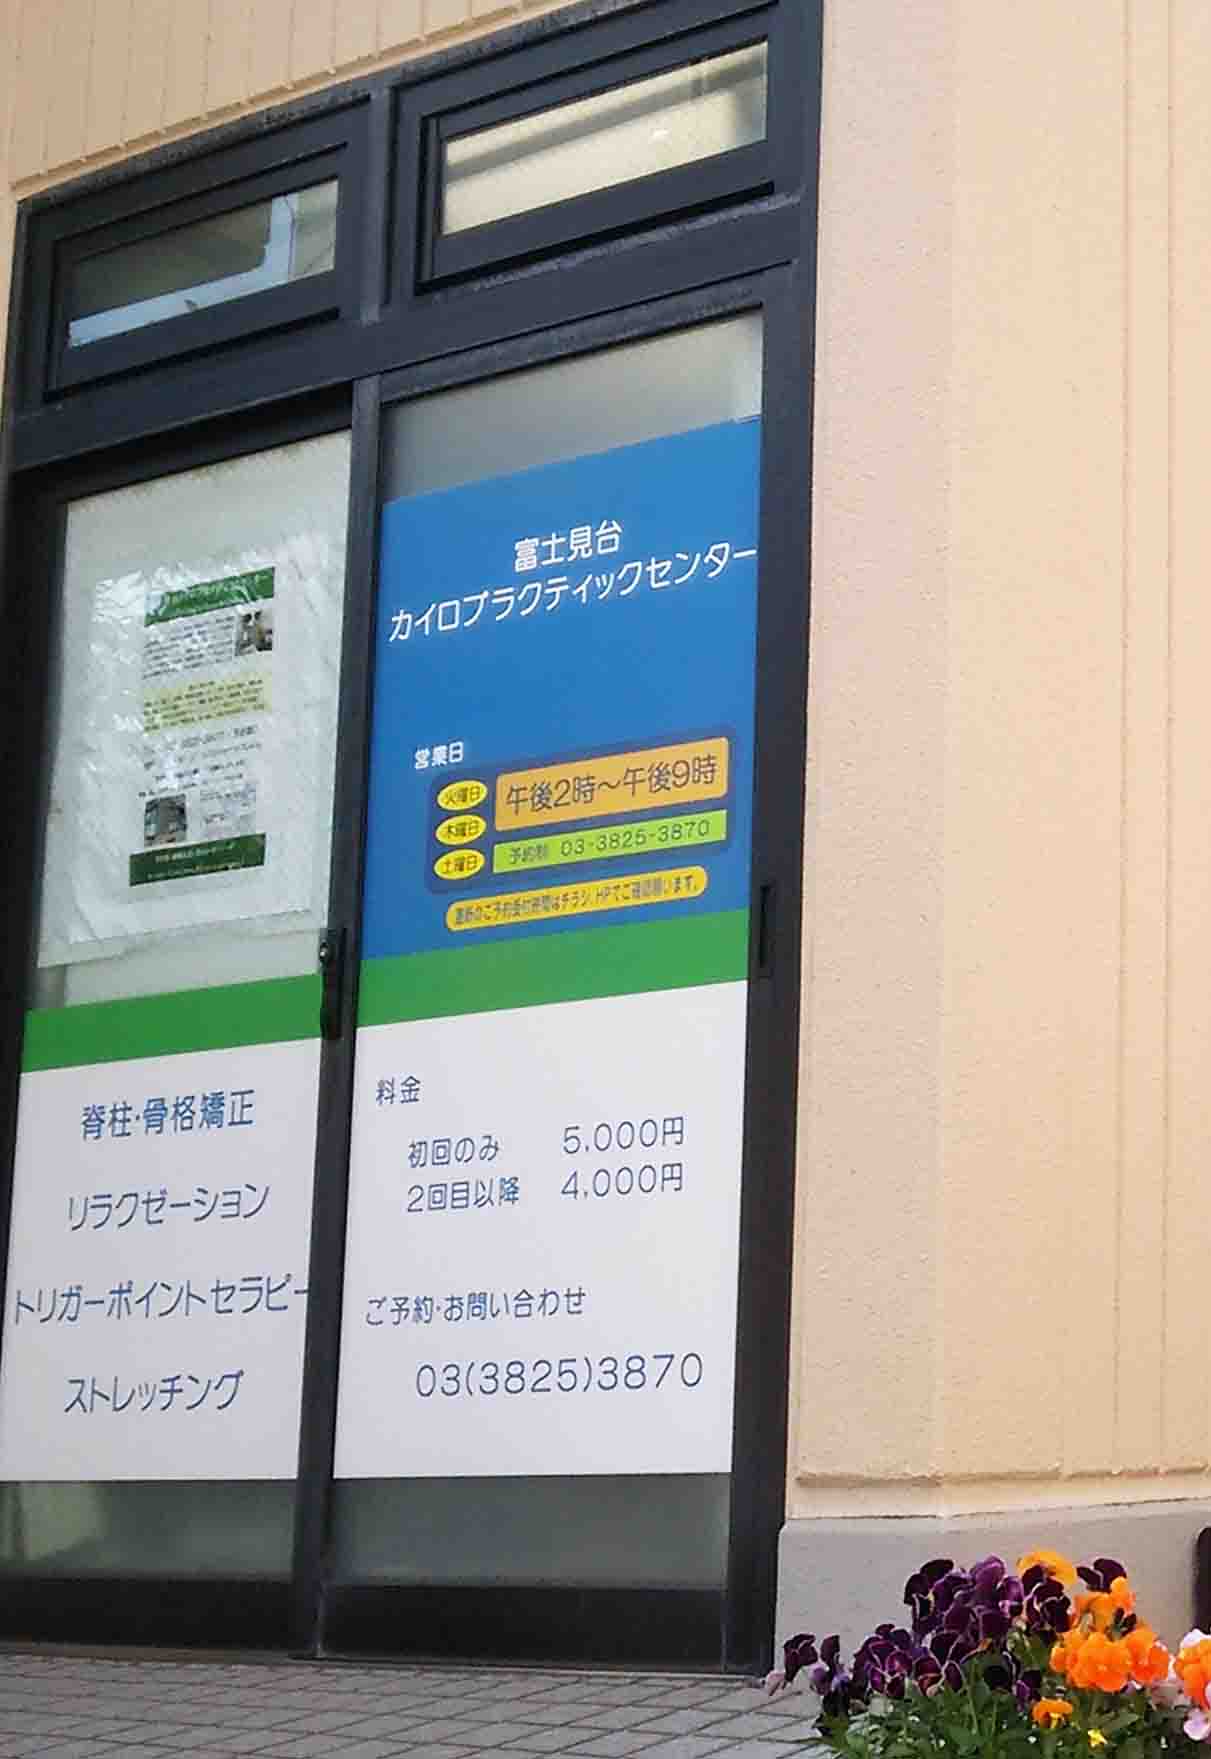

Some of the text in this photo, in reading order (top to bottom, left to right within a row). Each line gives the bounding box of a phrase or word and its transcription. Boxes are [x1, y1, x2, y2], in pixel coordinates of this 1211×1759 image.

[513, 520, 622, 573] 富士見台
[389, 542, 757, 642] カイロプラクティックセンター
[414, 741, 464, 769] 営業日
[560, 820, 711, 856] 03-3825-3870
[376, 1075, 422, 1106] 料金
[81, 1090, 255, 1141] 脊柱・骨格矯正
[407, 1135, 500, 1168] 初回のみ
[68, 1184, 269, 1231] リラクゼーション
[407, 1176, 520, 1213] 2回目以降
[15, 1273, 309, 1324] トリガーポイントセラピー
[365, 1286, 587, 1326] ご予約・お問い合わせ
[64, 1370, 244, 1413] ストレッチング
[416, 1352, 703, 1398] 03(3825)3870
